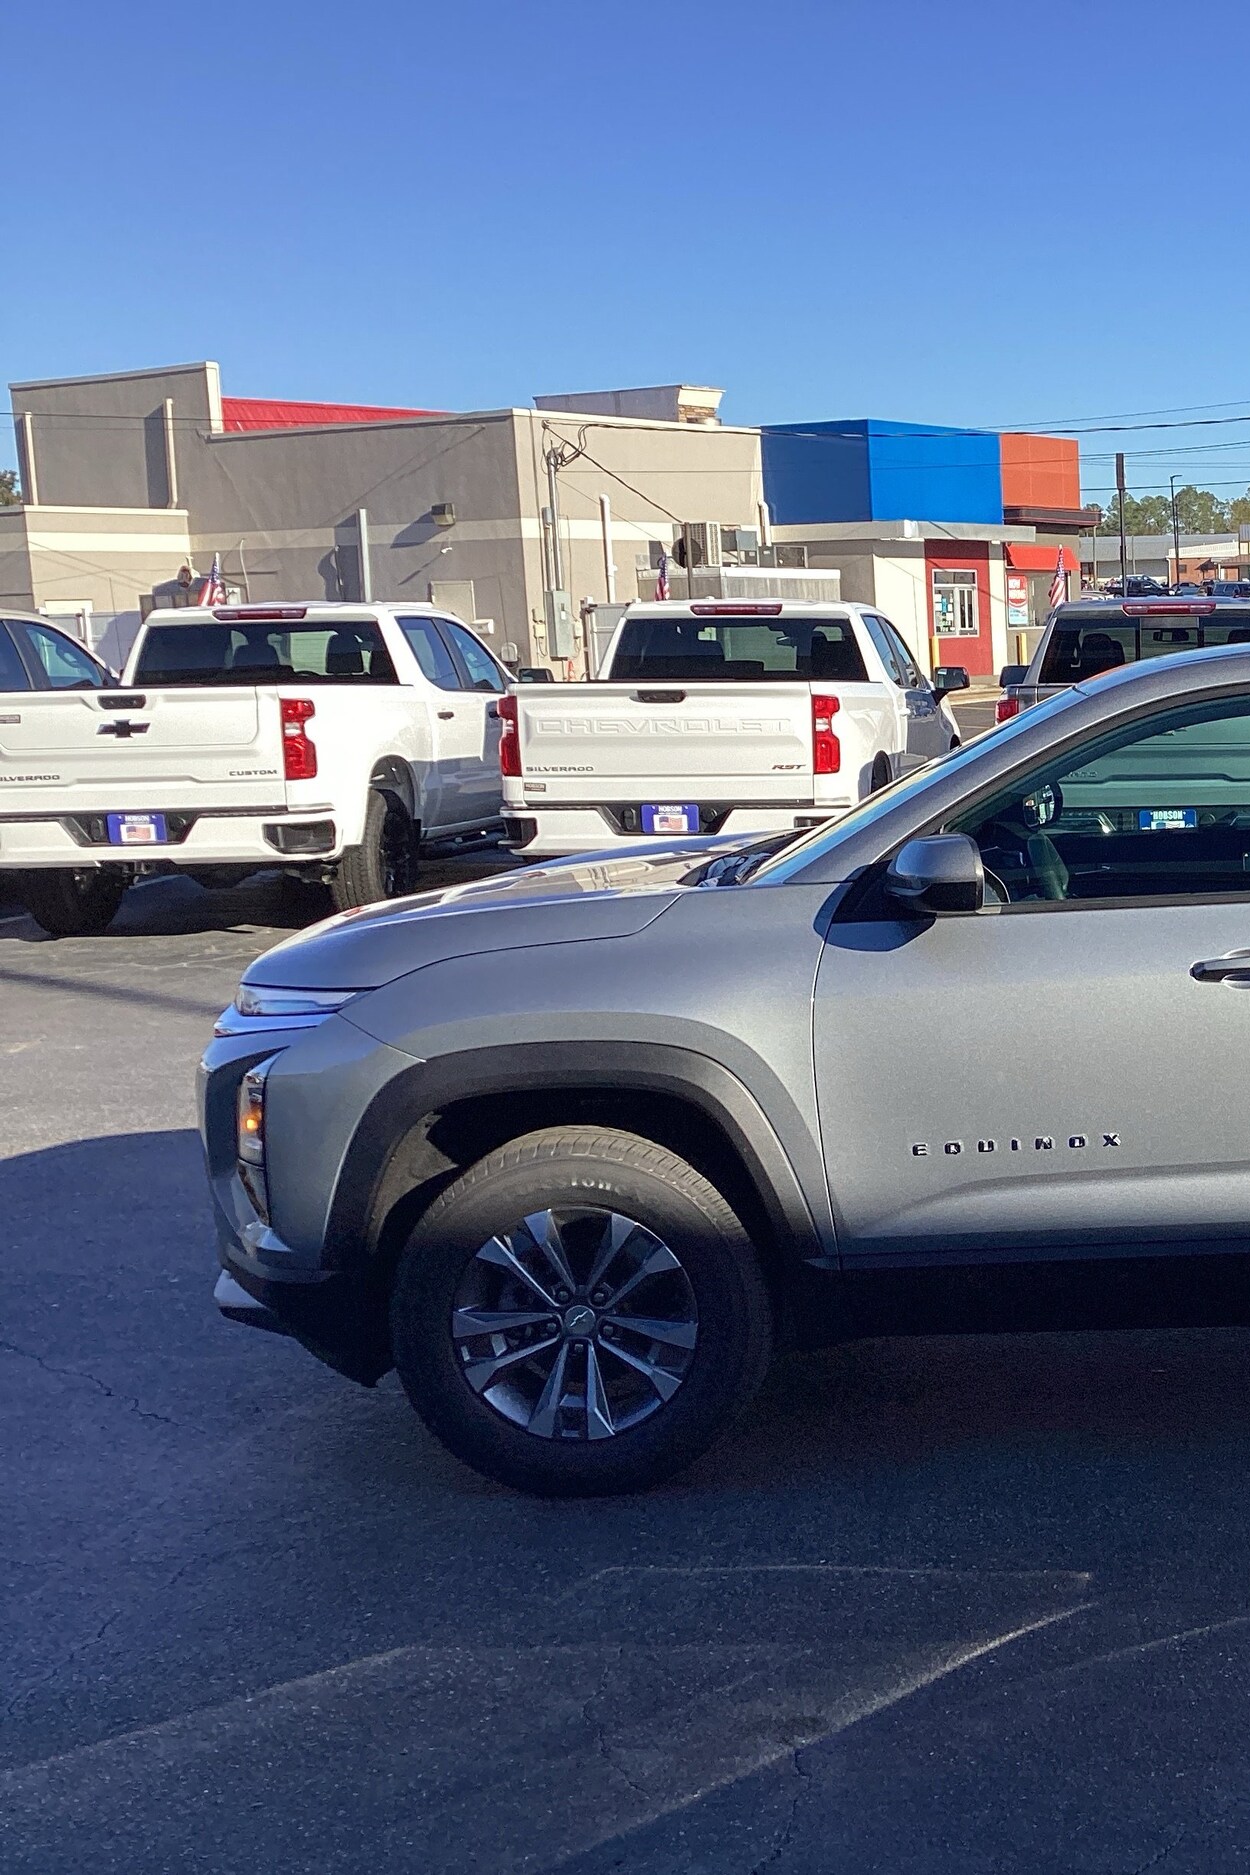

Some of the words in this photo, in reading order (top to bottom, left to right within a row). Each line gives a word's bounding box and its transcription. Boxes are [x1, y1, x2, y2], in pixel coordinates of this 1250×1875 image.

[536, 718, 791, 735] CHEVROLET
[0, 774, 61, 782] ILVERADO
[228, 769, 278, 777] CUSTOM
[1152, 810, 1183, 820] HOBSON
[911, 1132, 1121, 1157] EQUINOX
